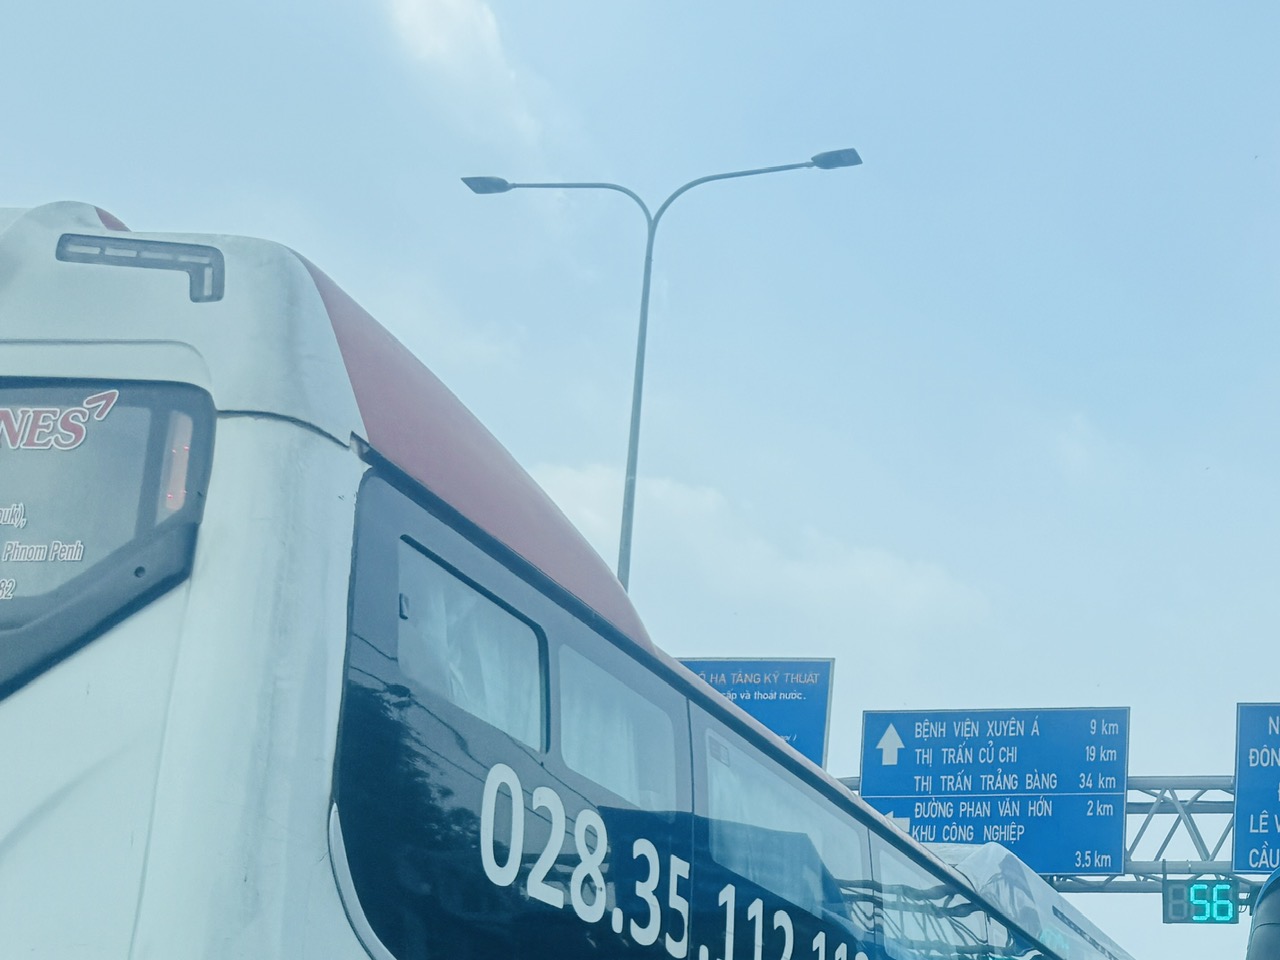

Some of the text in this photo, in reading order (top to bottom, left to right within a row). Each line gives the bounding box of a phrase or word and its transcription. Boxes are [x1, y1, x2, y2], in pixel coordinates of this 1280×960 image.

[3, 541, 84, 561] Phnom Penh
[915, 715, 1040, 740] BỆNH VIỆN XUYÊN Á
[1090, 719, 1119, 735] 9 km
[915, 740, 1017, 767] THỊ TRẤN CỦ CHI
[1085, 745, 1117, 762] 19 km
[914, 768, 1057, 794] THỊ TRẤN TRẢNG BÀNG
[1079, 773, 1116, 789] 34 km
[914, 797, 954, 819] ĐƯỜNG
[959, 801, 991, 818] PHAN
[998, 797, 1020, 817] VĂN
[1087, 800, 1114, 816] 2 km
[1250, 809, 1268, 833] LÊ
[912, 821, 1025, 844] KHU CÔNG NGHIỆP
[1074, 851, 1112, 868] 3.5 km
[1249, 841, 1280, 869] CẦU
[1190, 884, 1233, 921] 56
